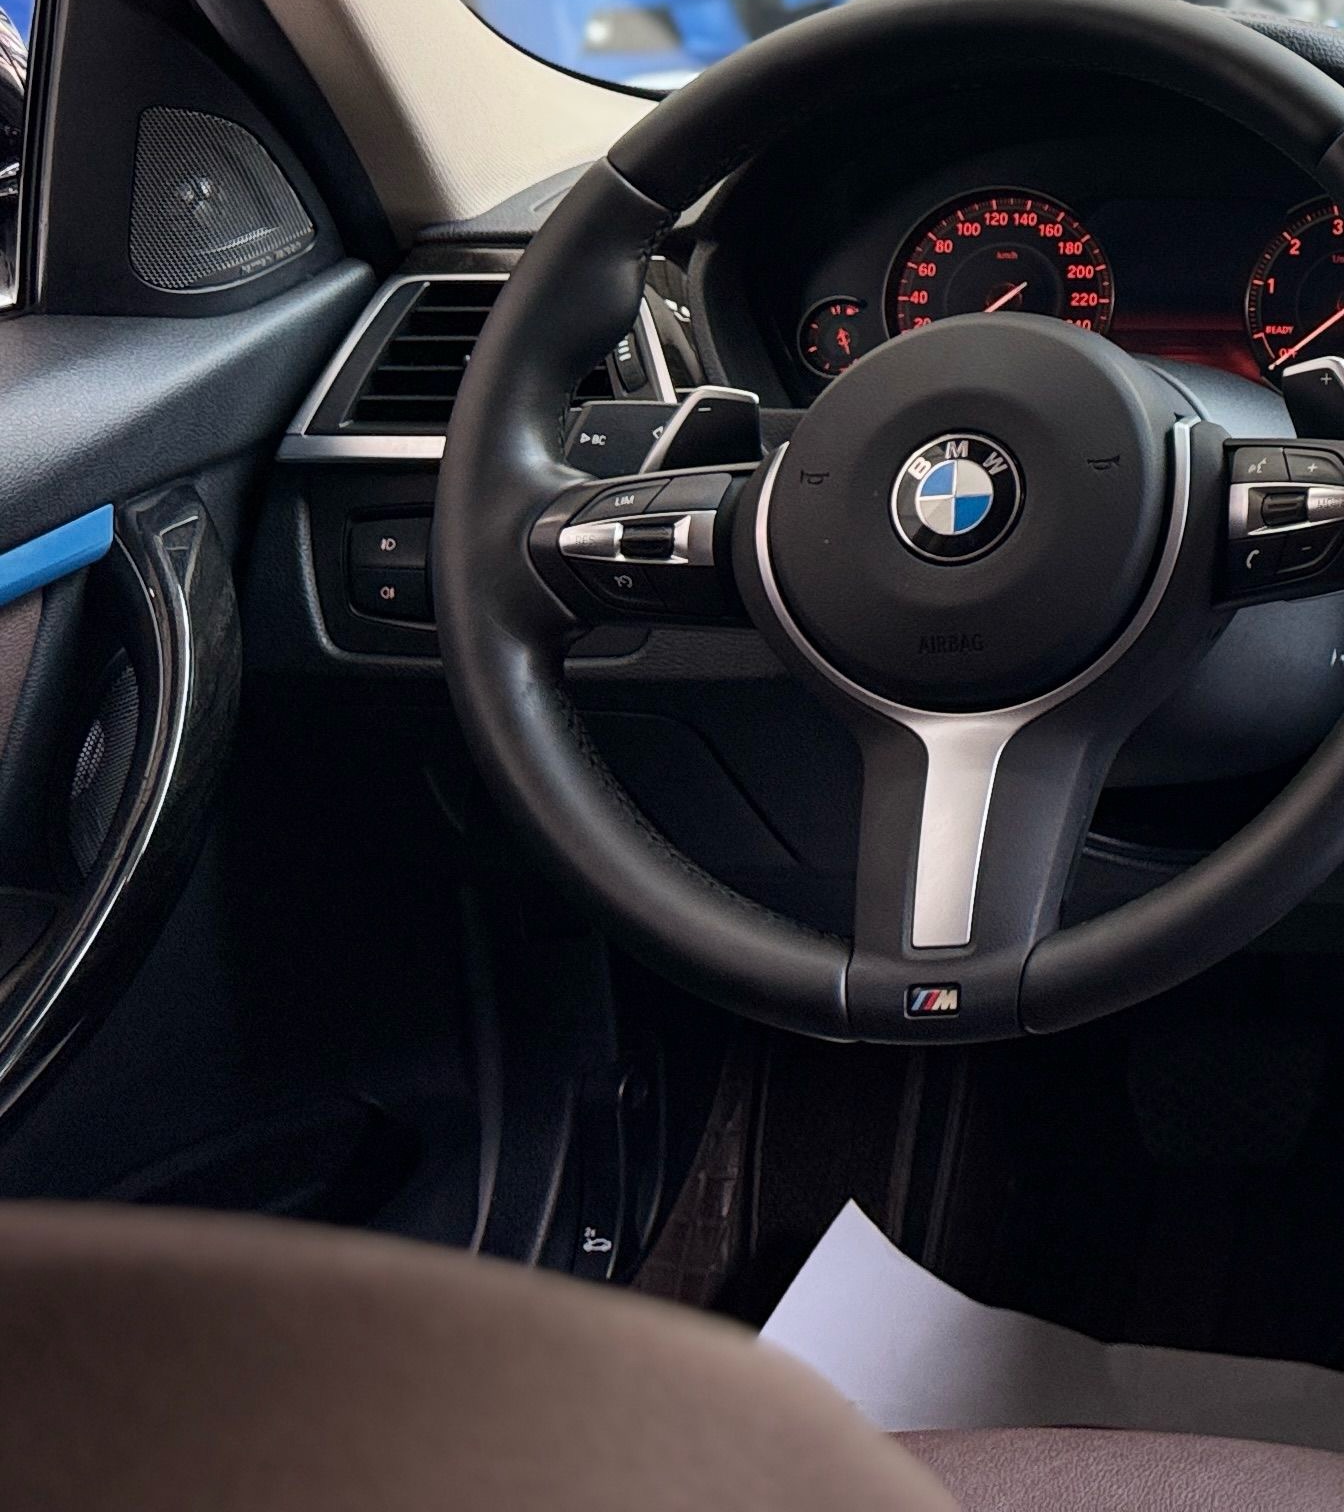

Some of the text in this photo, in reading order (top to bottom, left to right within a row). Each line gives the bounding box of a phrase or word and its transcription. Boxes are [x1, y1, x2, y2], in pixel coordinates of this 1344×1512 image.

[984, 212, 1008, 226] 120
[1013, 212, 1037, 226] 140
[957, 223, 981, 237] 100
[1038, 224, 1063, 238] 160
[1332, 219, 1344, 236] 3
[935, 240, 953, 254] 80
[1058, 241, 1083, 256] 180
[1289, 239, 1300, 256] 2
[918, 263, 936, 277] 60
[1067, 265, 1094, 279] 200
[1266, 277, 1276, 294] 1
[909, 290, 928, 305] 40
[1071, 292, 1098, 306] 220
[1265, 325, 1294, 335] READY
[907, 439, 1009, 480] BMW
[614, 494, 635, 507] LIM
[918, 633, 985, 654] AIRBAG
